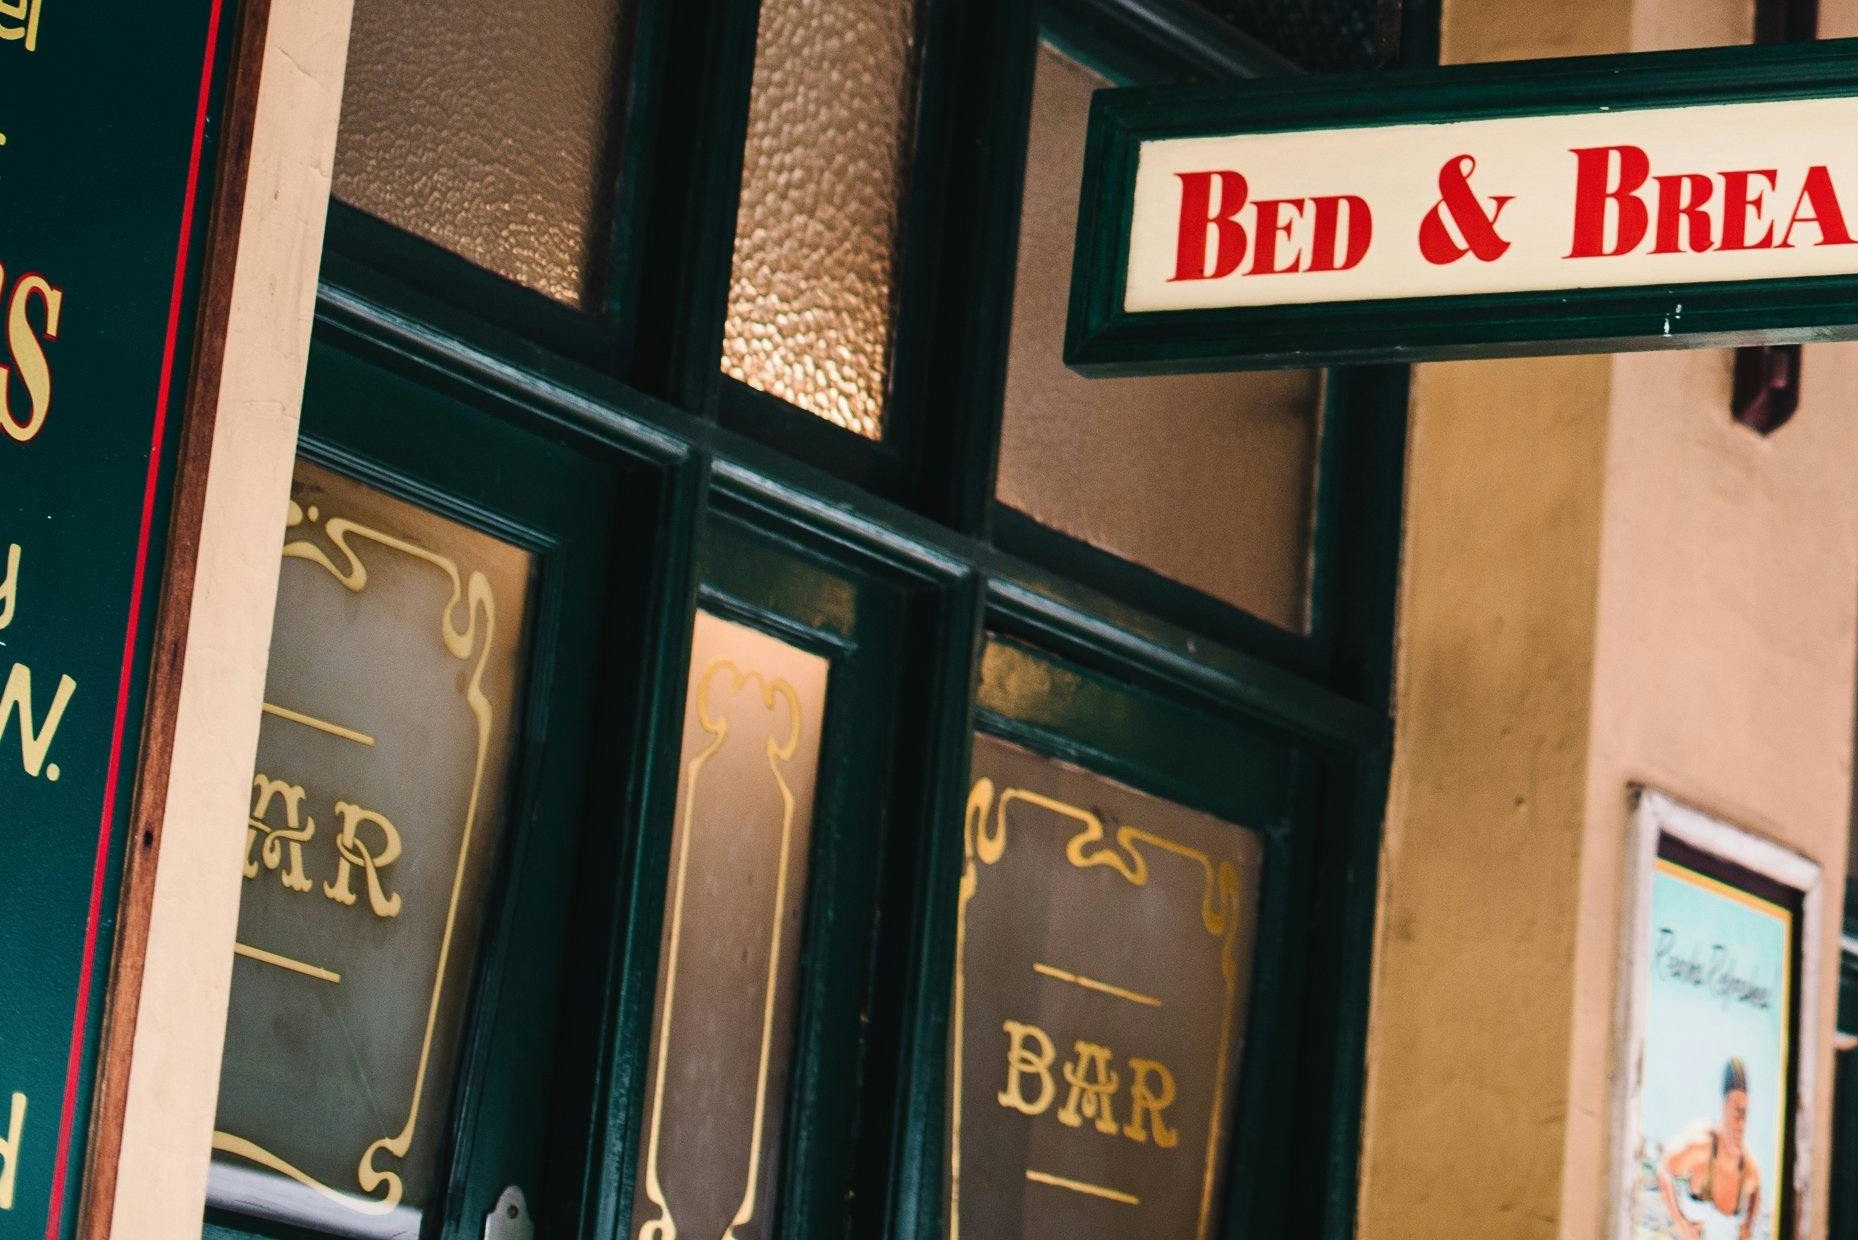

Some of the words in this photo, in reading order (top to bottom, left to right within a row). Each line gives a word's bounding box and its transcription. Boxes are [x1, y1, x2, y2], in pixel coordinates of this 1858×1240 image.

[1166, 169, 1374, 282] BED
[1417, 153, 1515, 266] &
[997, 1019, 1180, 1149] BAR
